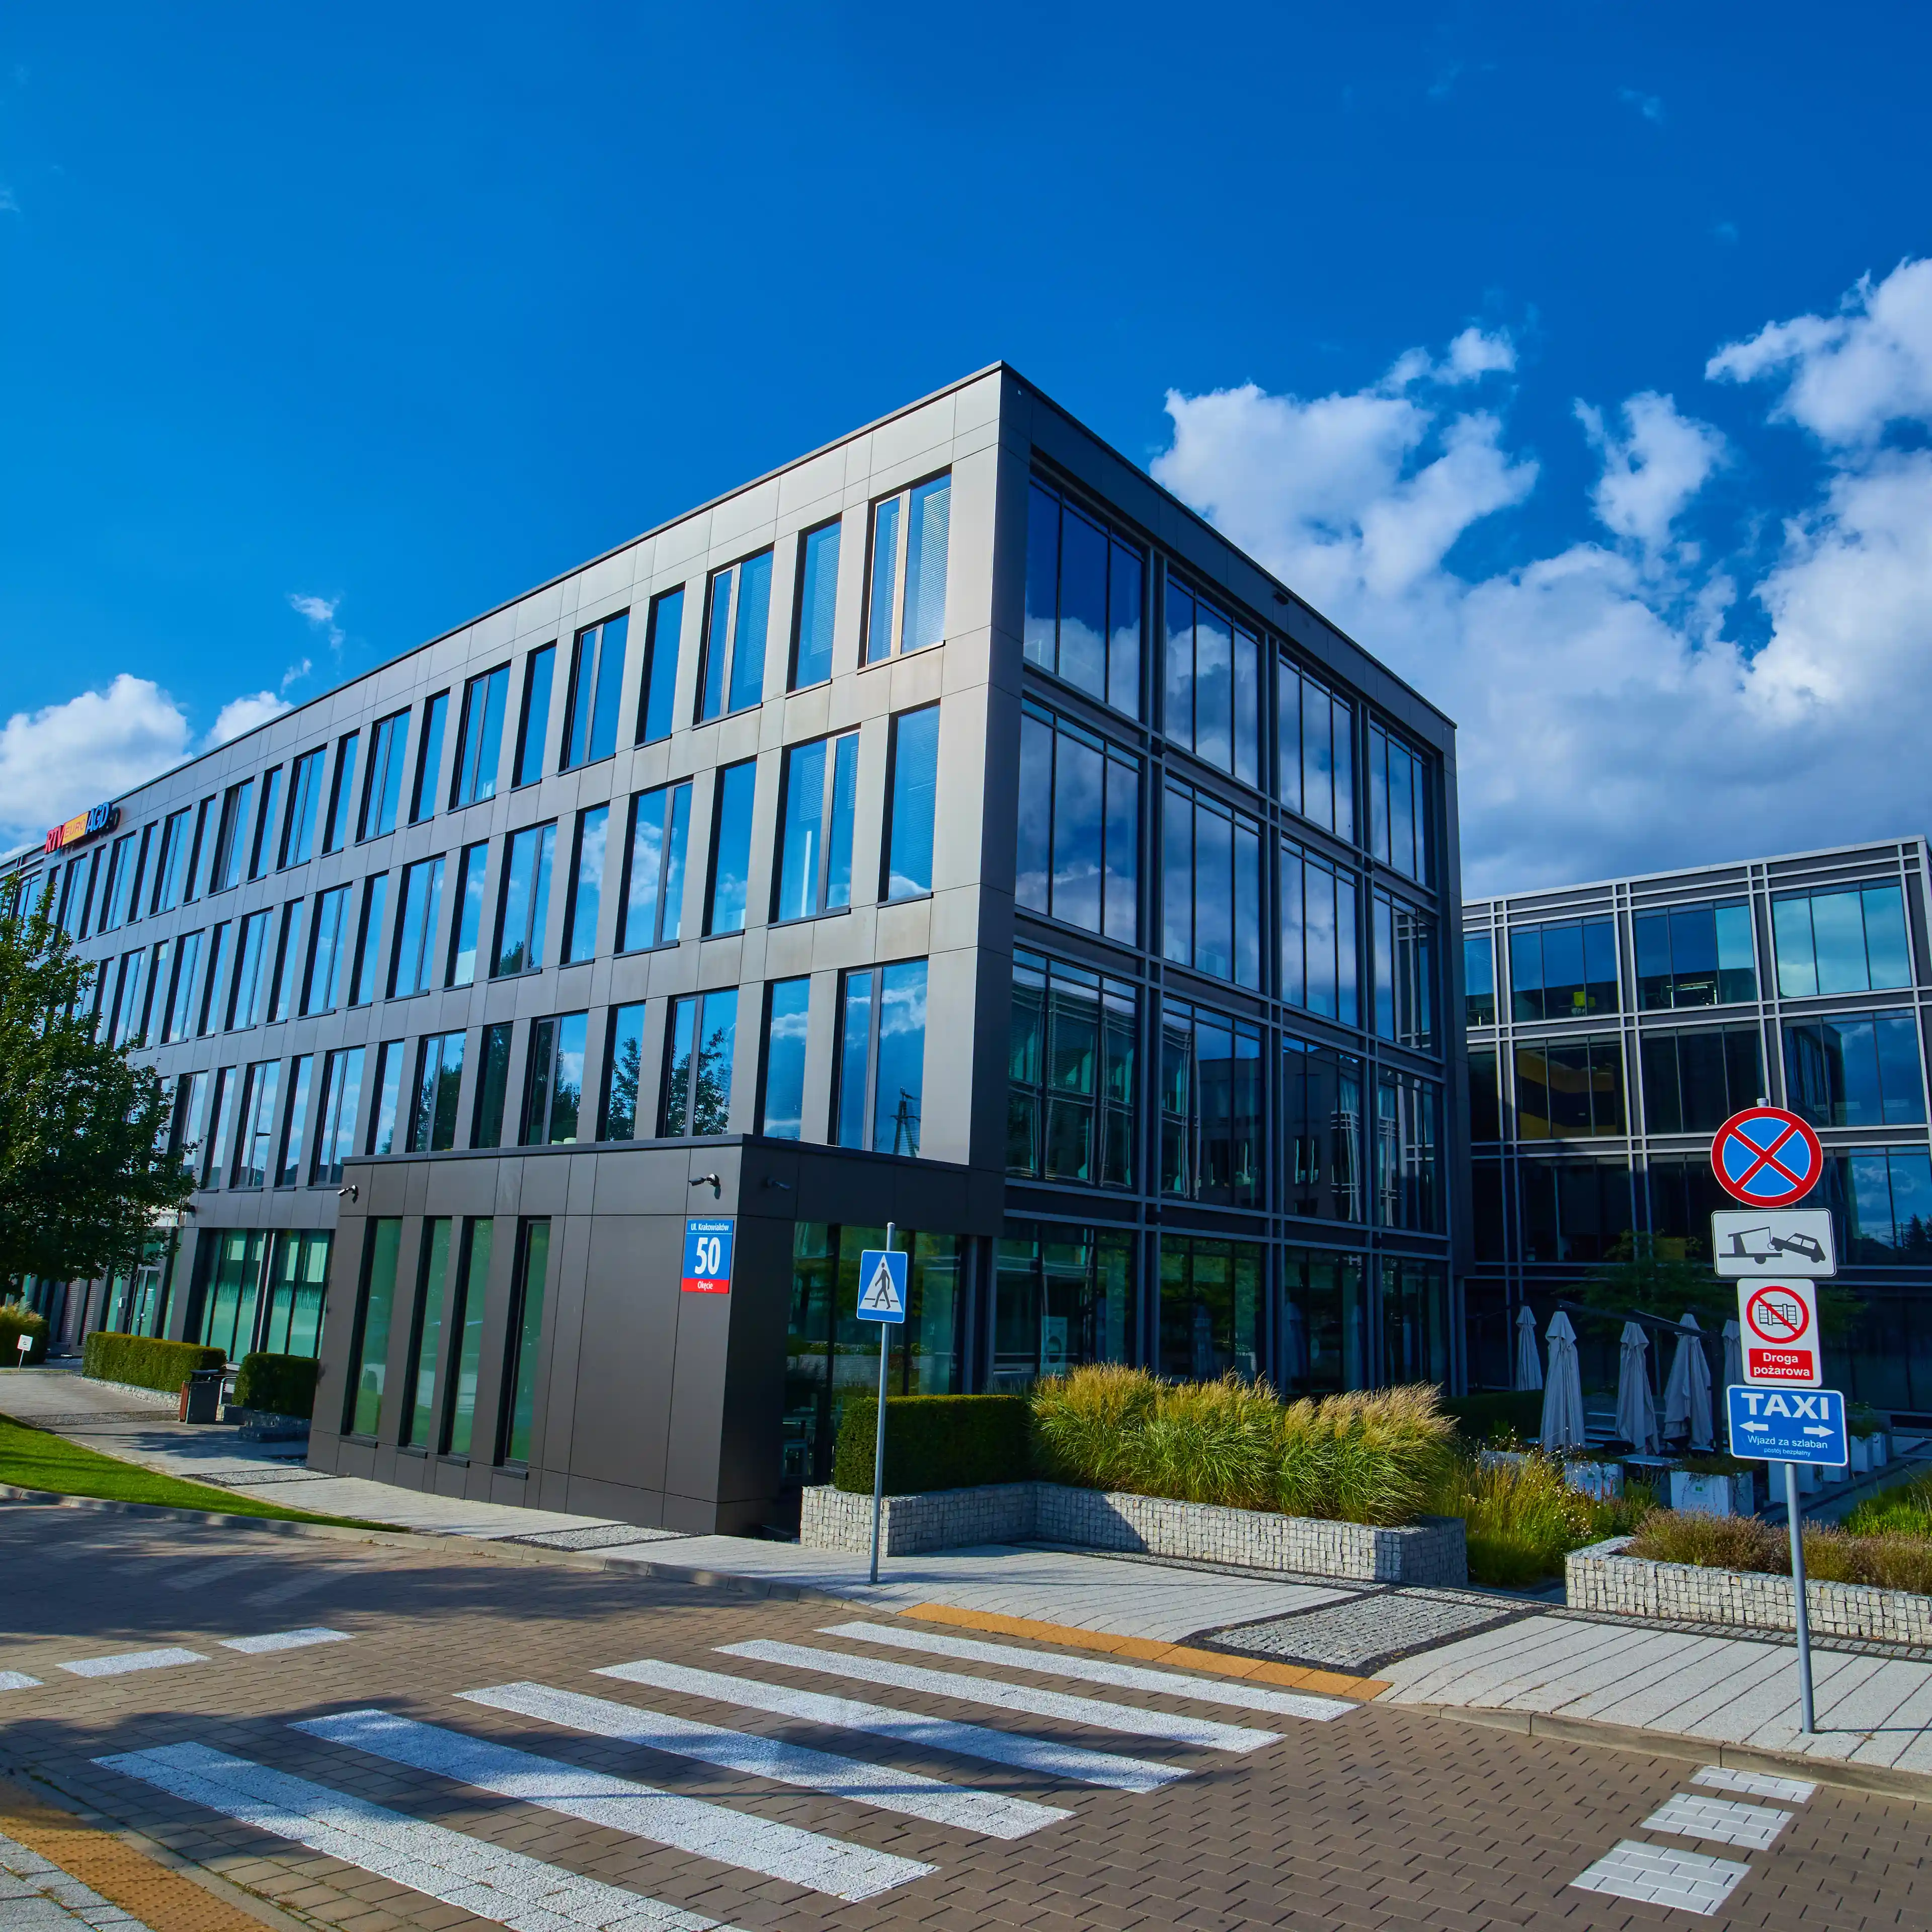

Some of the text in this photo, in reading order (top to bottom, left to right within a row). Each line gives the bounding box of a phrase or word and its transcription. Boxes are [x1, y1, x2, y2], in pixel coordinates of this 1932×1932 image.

[44, 802, 112, 854] RTV EURO AGD
[698, 1223, 729, 1231] Krakowiaków
[694, 1237, 720, 1275] 50
[697, 1281, 713, 1291] Okęcie
[1762, 1352, 1798, 1364] Droga
[1753, 1365, 1810, 1377] pożarowa
[1741, 1393, 1829, 1420] TAXI
[1747, 1435, 1776, 1445] Wjazd
[1792, 1439, 1828, 1449] szlaban
[1764, 1447, 1782, 1455] postój
